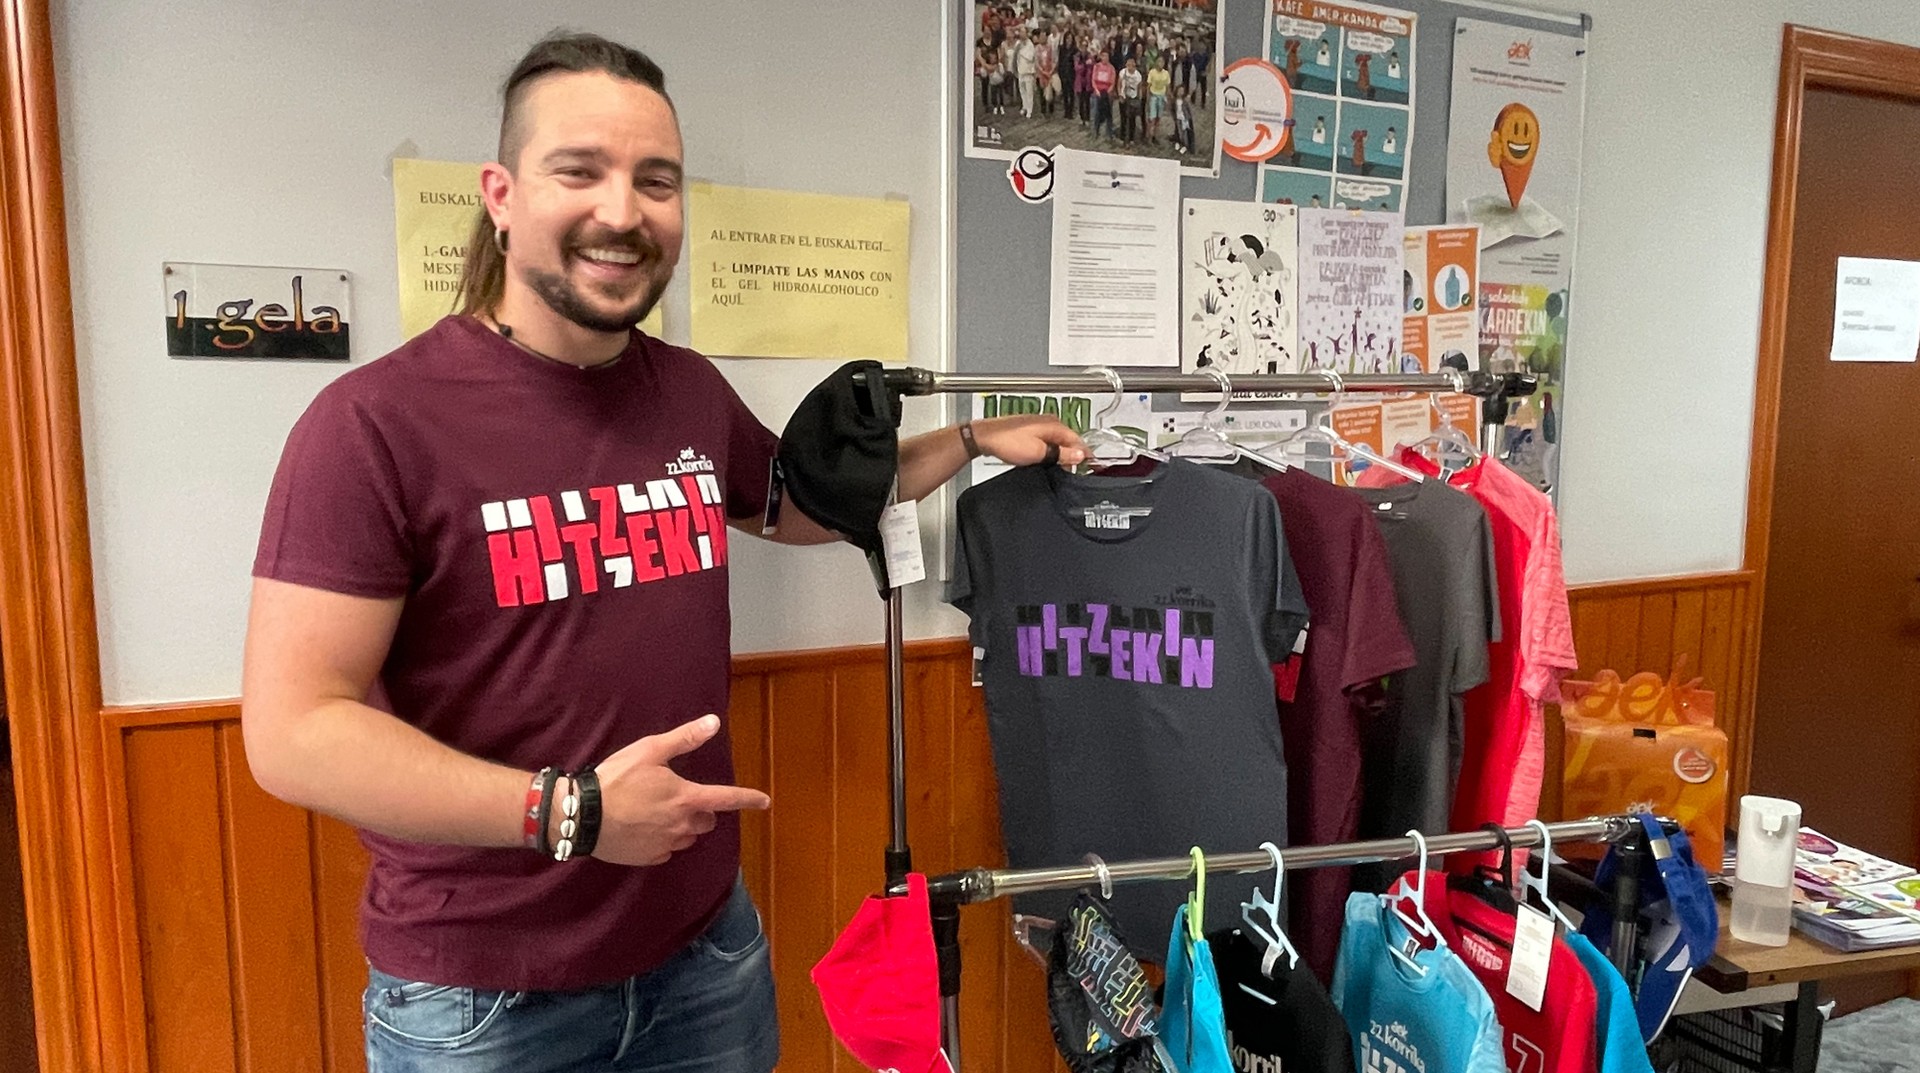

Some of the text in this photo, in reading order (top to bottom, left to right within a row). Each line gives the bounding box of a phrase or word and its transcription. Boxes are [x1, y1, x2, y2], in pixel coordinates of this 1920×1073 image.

[1263, 209, 1276, 222] 30
[710, 229, 726, 240] AL
[729, 231, 777, 245] ENTRAR
[780, 234, 795, 245] EN
[799, 236, 812, 247] EL
[732, 263, 790, 276] LIMPIATE
[797, 267, 818, 278] LAS
[824, 269, 865, 280] MANOS
[870, 272, 892, 282] CON
[711, 278, 726, 288] EL
[738, 279, 760, 290] GEL
[773, 281, 879, 297] HIDROALCOHOLICO
[481, 473, 728, 608] HITZEKIN
[1016, 602, 1215, 689] HITZEKIN
